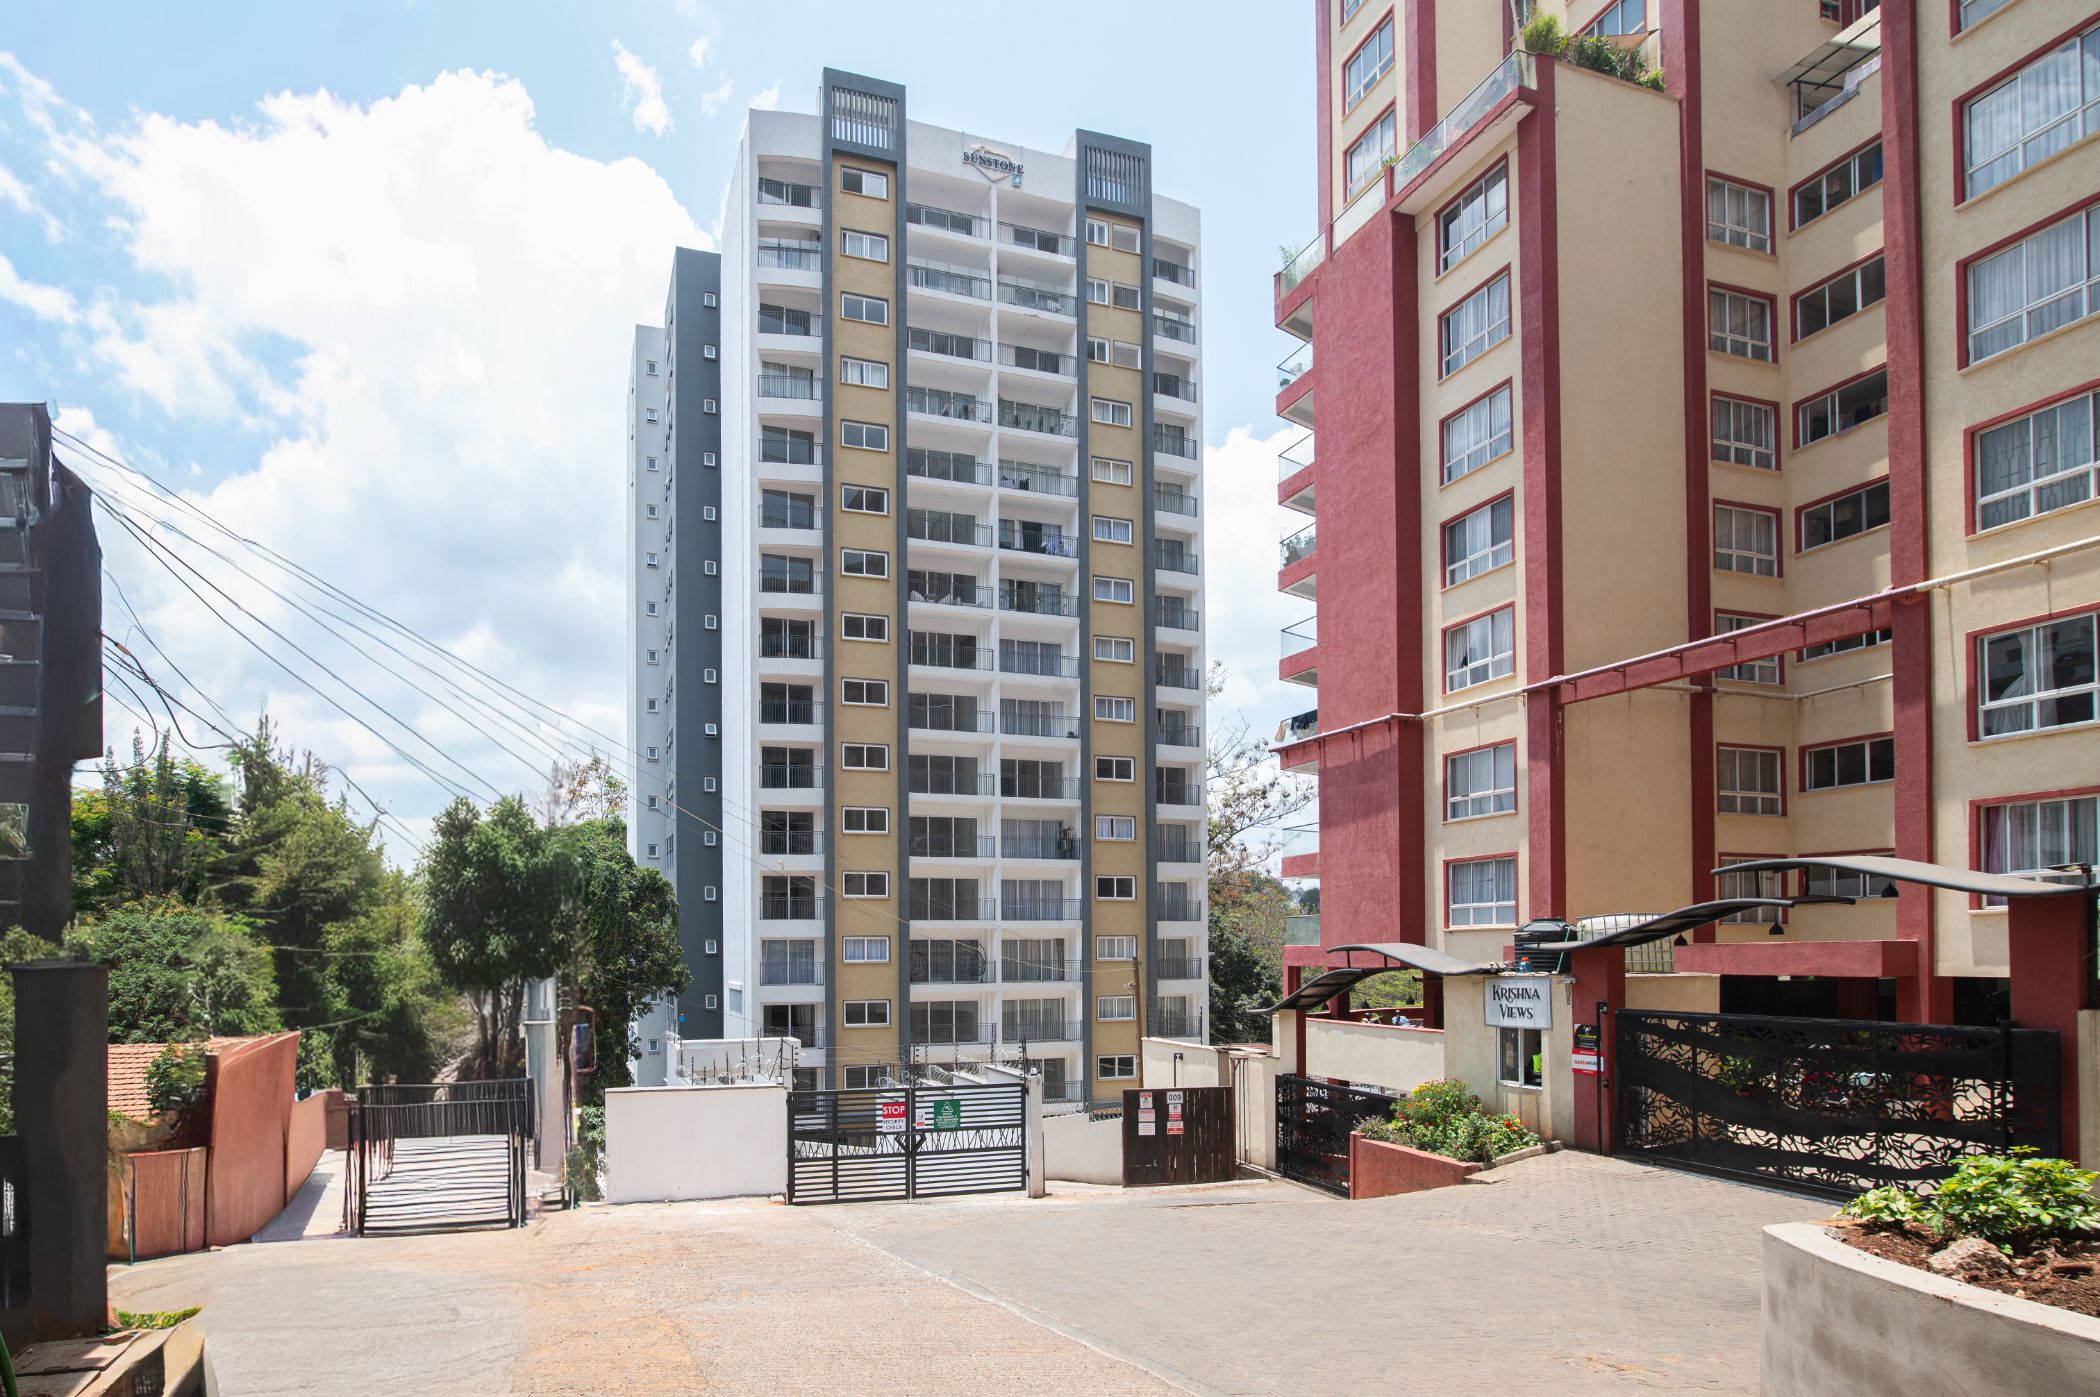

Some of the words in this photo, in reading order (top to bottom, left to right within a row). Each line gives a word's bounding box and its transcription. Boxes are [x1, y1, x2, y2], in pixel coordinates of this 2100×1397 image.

[963, 151, 1024, 174] SUNSTONE
[1492, 984, 1541, 1003] KRISHNA
[1499, 1003, 1534, 1020] VIEWS
[883, 1105, 905, 1115] STOP
